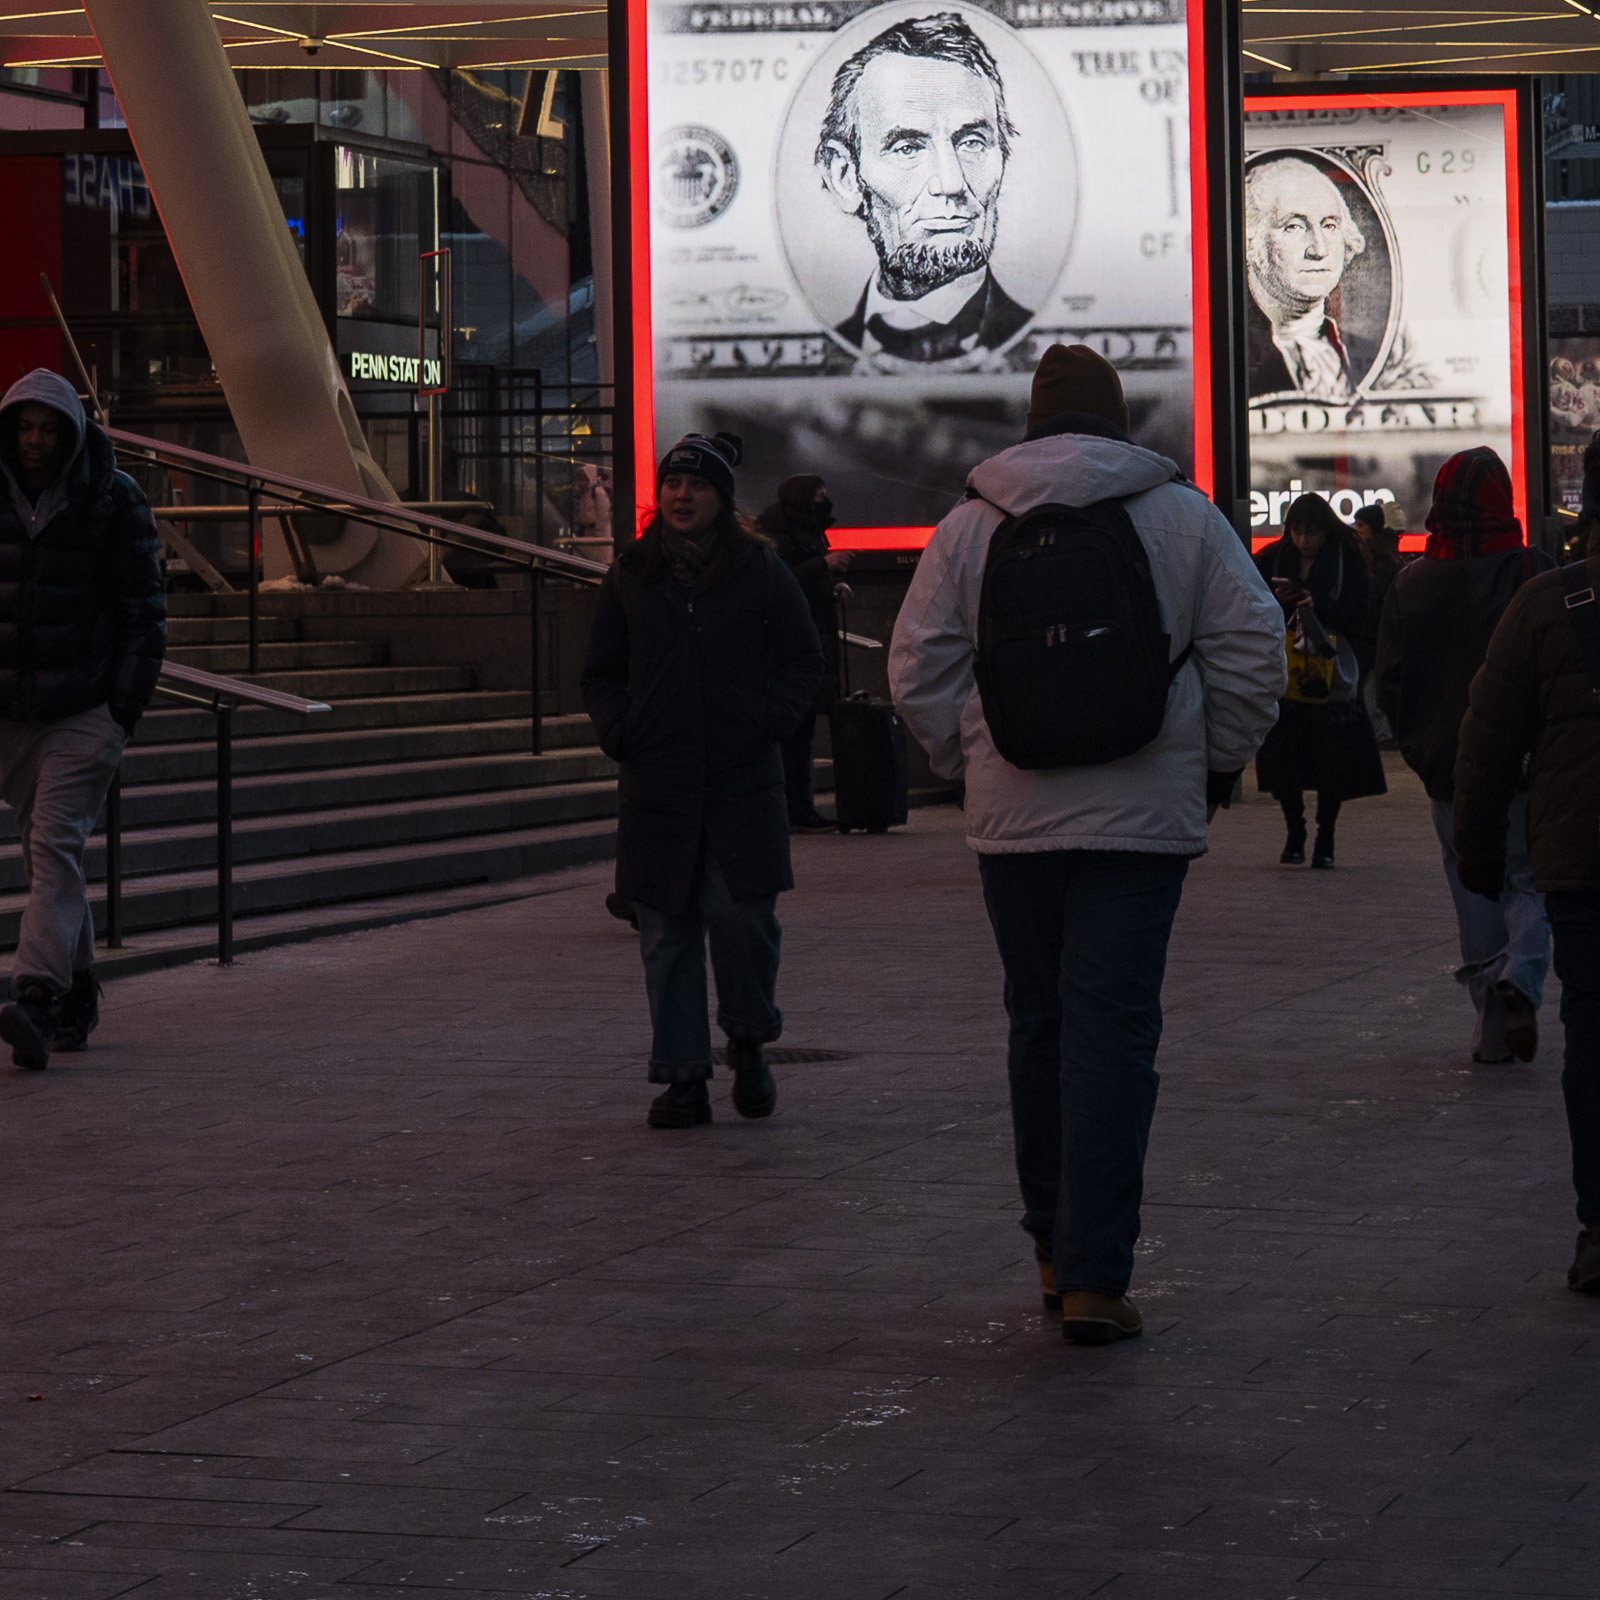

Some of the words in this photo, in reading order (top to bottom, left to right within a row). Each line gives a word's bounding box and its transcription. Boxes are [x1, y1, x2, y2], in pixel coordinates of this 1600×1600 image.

[660, 58, 763, 84] 25707
[352, 352, 388, 380] PENN
[389, 355, 441, 385] STATON
[1250, 480, 1395, 525] ero
